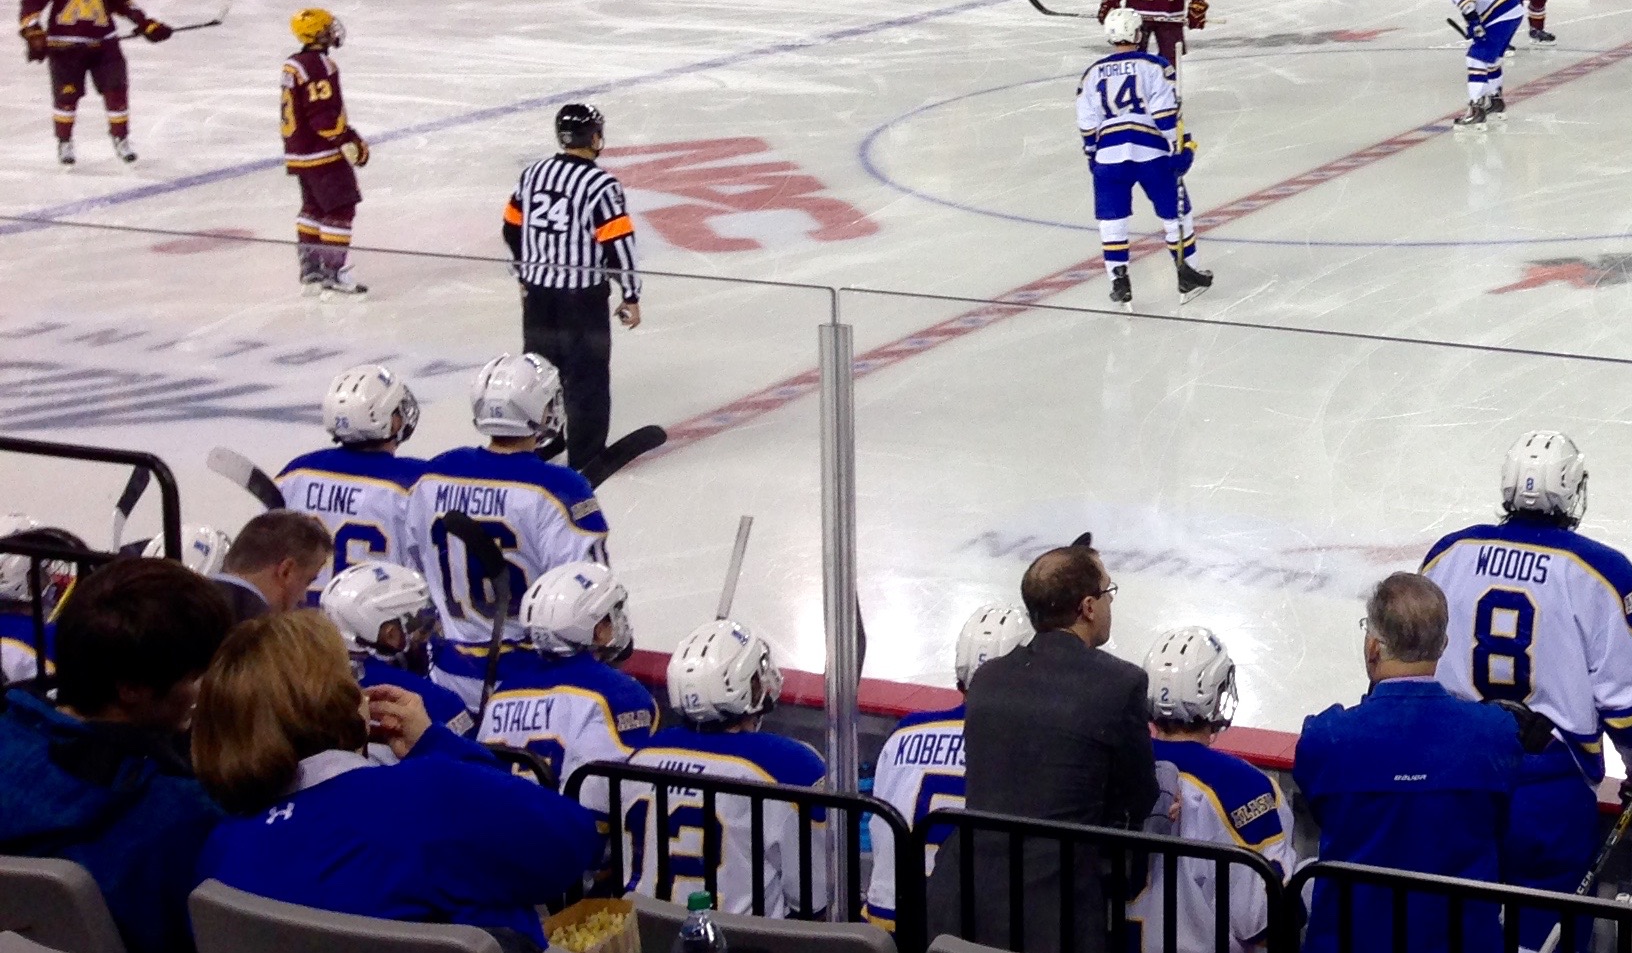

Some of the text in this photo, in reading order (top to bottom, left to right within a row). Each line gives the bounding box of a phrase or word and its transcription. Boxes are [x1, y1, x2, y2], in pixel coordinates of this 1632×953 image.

[1098, 61, 1136, 79] MORLEY
[306, 80, 333, 101] 13
[1096, 75, 1147, 119] 14
[529, 192, 570, 232] 24
[489, 406, 502, 418] 16
[306, 481, 362, 516] CLINE
[434, 484, 508, 517] MUNSON
[1525, 477, 1535, 491] 8
[431, 517, 530, 619] 16
[1475, 545, 1551, 584] WOODS
[1472, 586, 1537, 703] 8
[684, 694, 700, 708] 12
[1161, 687, 1169, 702] 2
[492, 698, 556, 733] STALEY
